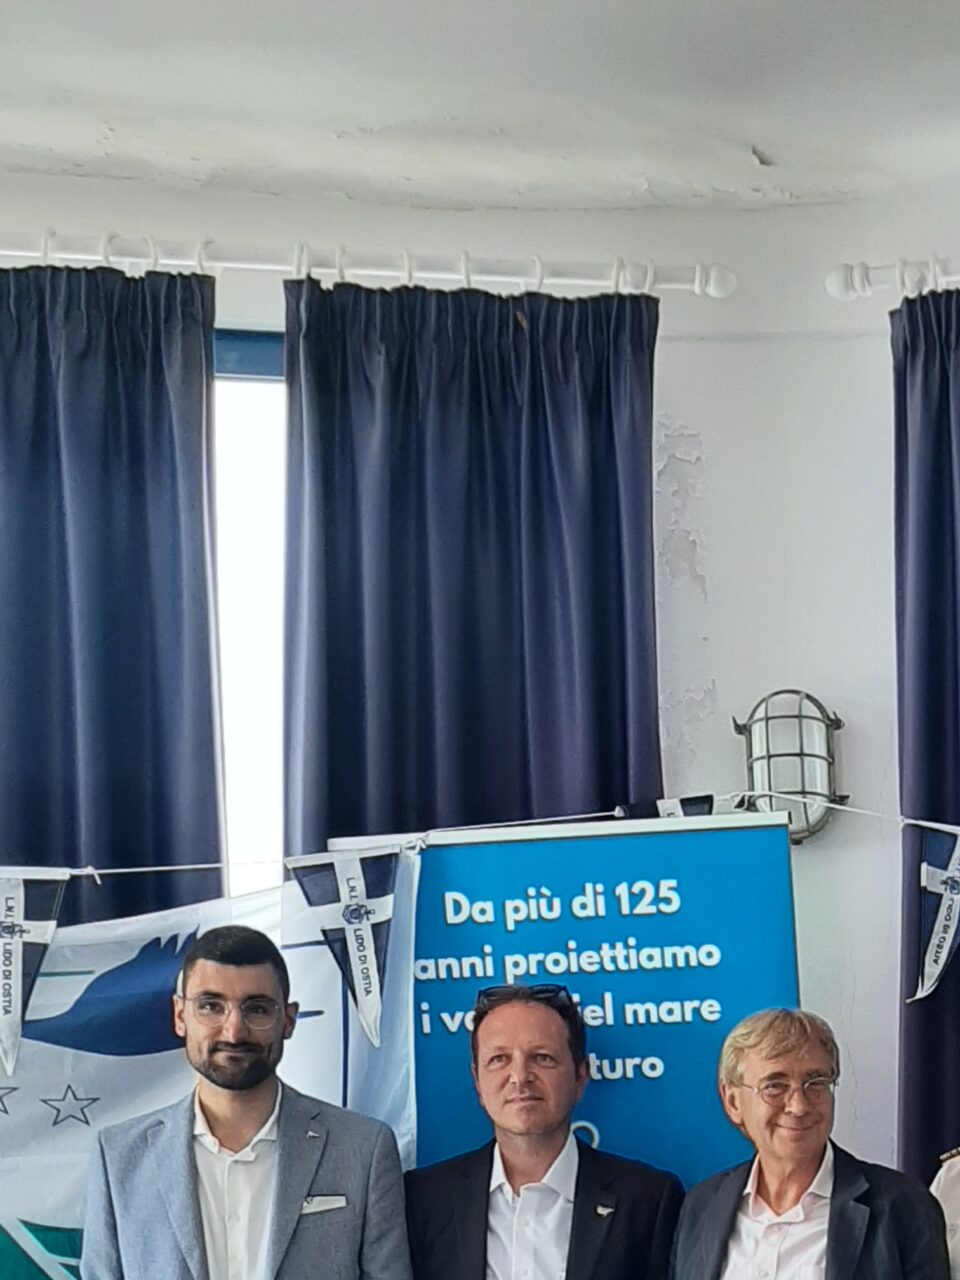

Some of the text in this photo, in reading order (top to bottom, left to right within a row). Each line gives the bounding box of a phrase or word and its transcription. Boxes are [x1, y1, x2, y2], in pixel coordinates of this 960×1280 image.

[444, 879, 681, 930] Da più di 125
[2, 943, 13, 967] LIDO
[353, 928, 366, 953] LIDO
[2, 969, 13, 980] DI
[358, 954, 368, 966] DI
[414, 936, 721, 986] anni proiettiamo
[361, 967, 373, 997] OSTIA
[2, 982, 13, 1016] OSTIA
[420, 1001, 432, 1034] i
[572, 992, 615, 1027] el
[623, 997, 721, 1026] mare
[588, 1053, 664, 1081] turo
